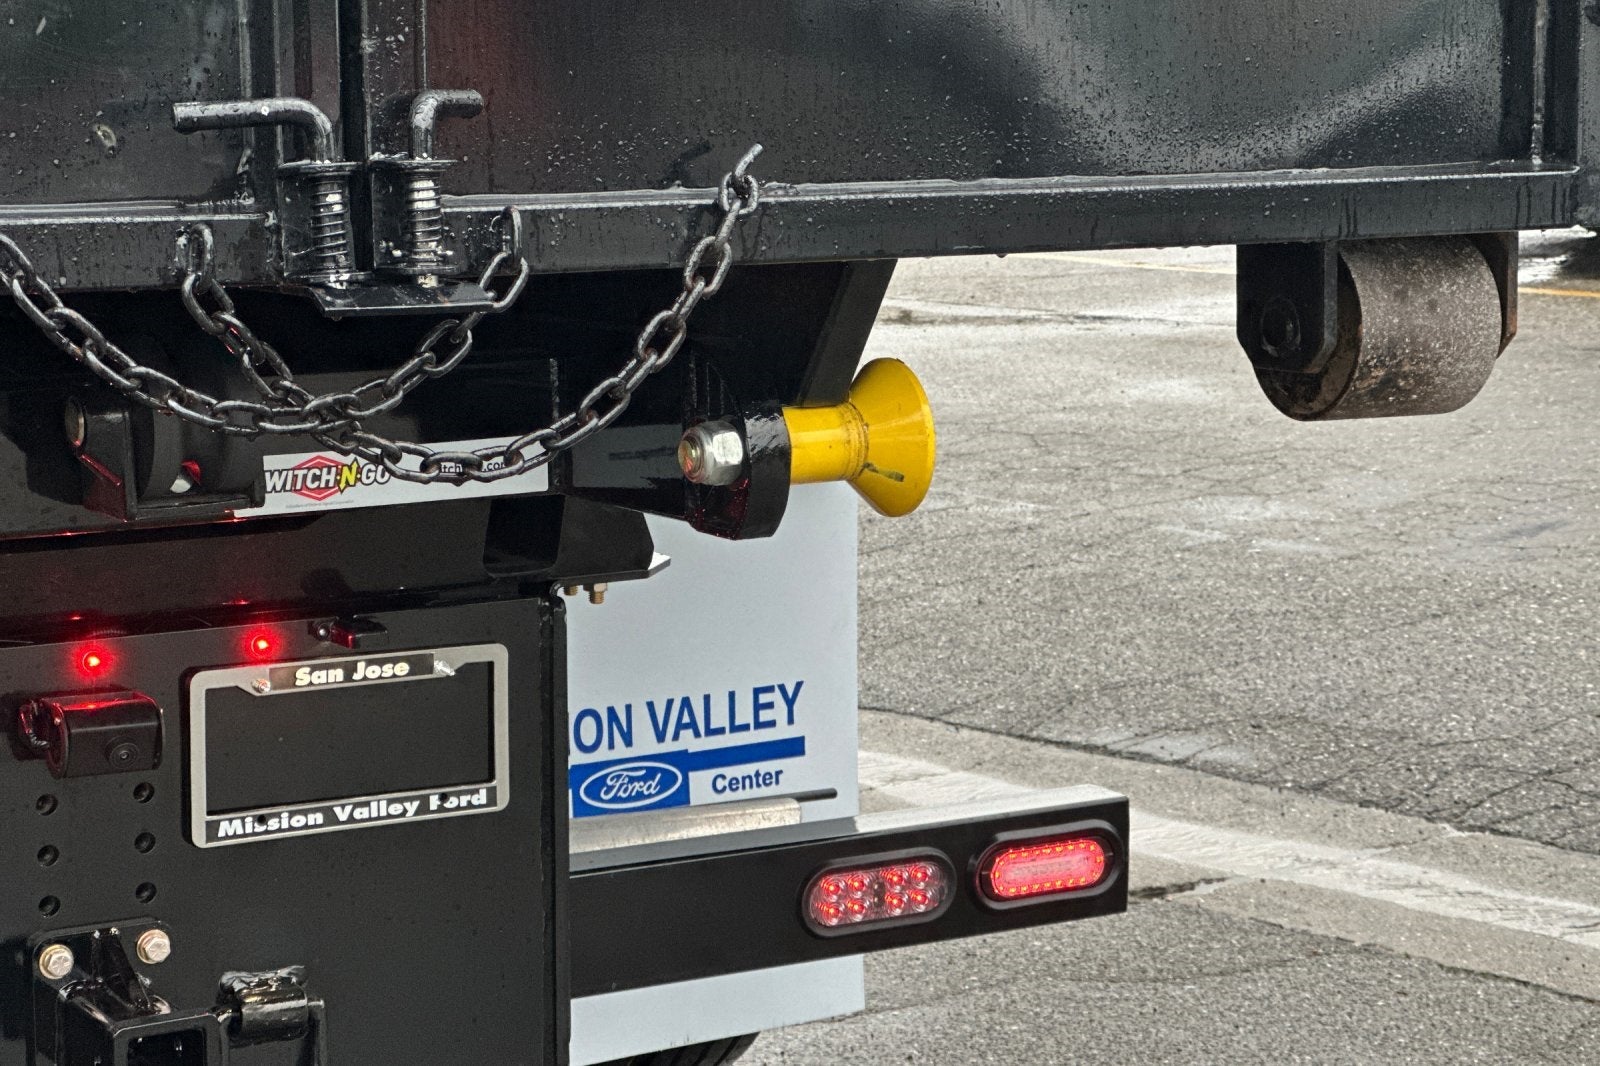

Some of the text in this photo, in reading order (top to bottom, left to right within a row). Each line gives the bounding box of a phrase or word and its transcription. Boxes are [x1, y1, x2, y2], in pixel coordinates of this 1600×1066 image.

[295, 660, 410, 686] San Jose
[646, 681, 804, 744] VALLEY
[600, 769, 661, 800] Ford
[712, 769, 783, 795] Center
[333, 799, 420, 823] Valley
[429, 788, 487, 811] Ford
